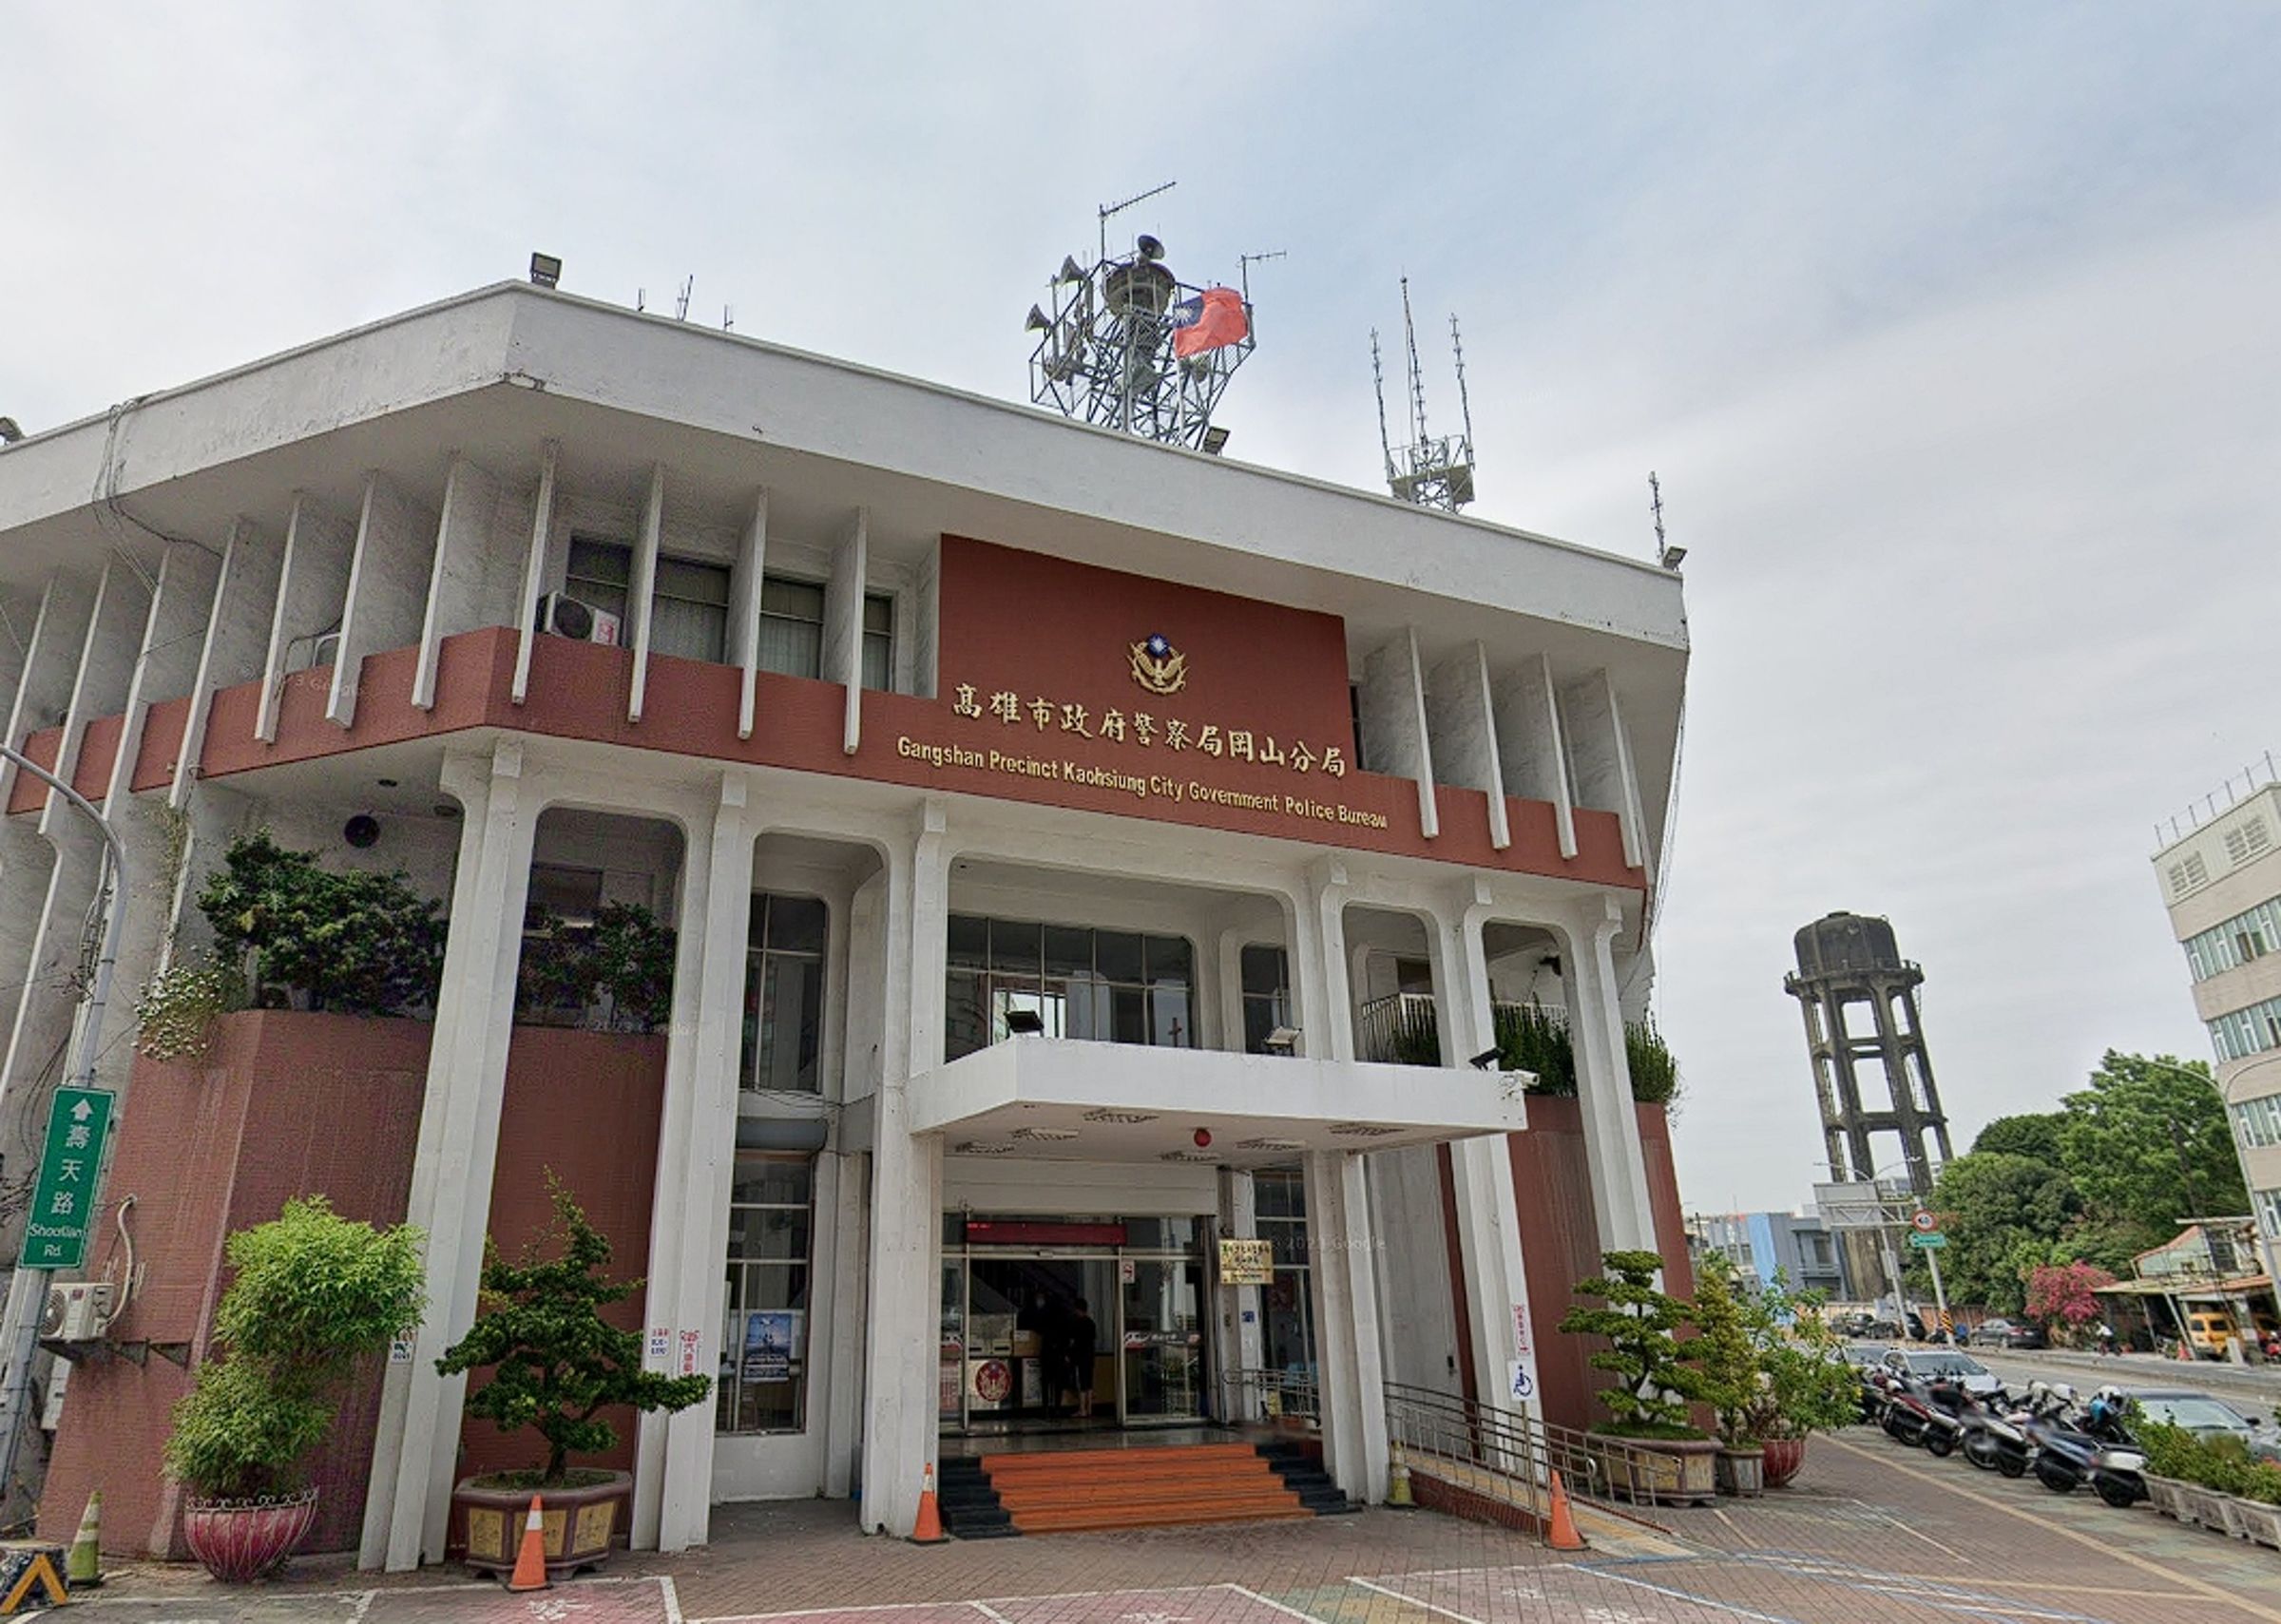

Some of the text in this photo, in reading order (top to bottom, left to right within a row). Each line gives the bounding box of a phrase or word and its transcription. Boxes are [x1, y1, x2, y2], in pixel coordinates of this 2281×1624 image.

[897, 736, 1388, 829] Gangshan Precinct Kaohsiung City Government Police Bureau
[50, 1124, 90, 1215] 壽天路
